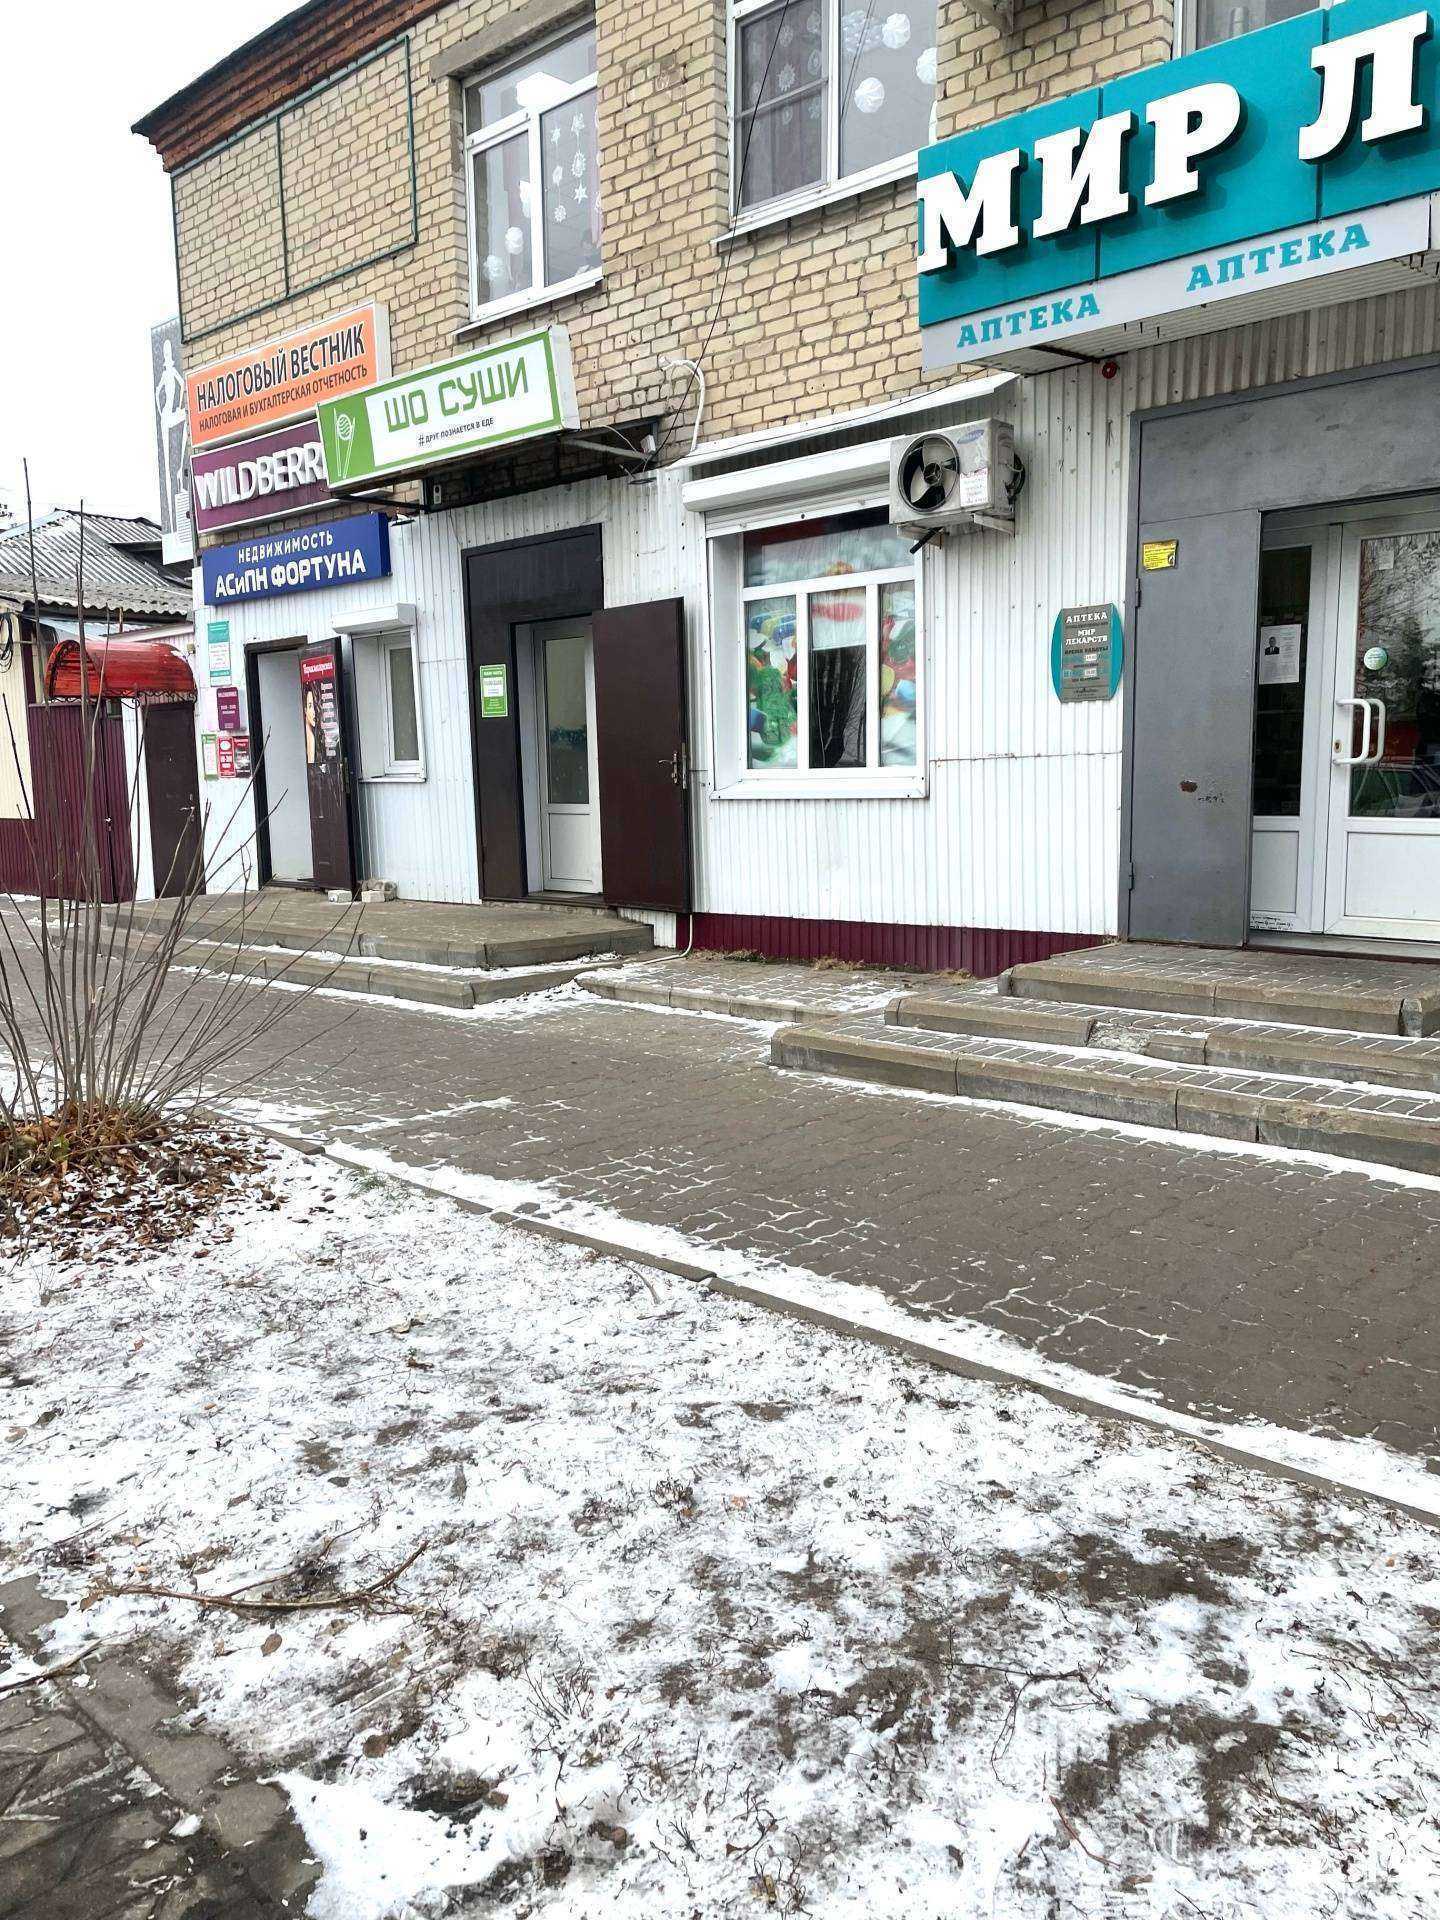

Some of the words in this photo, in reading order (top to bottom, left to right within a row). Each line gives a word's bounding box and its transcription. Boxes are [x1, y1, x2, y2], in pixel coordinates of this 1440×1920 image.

[917, 82, 1241, 274] МИР
[957, 292, 1100, 348] АПТЕКА
[1186, 223, 1370, 292] АПТЕКА
[197, 349, 287, 412] НАЛОГОВЫЙ
[291, 324, 365, 379] ВЕСТНИК
[200, 408, 242, 432] НАЛОГОВАЯ
[243, 404, 249, 417] И
[250, 382, 311, 416] БУХГАЛТЕРСКАЯ
[313, 364, 367, 393] ОТЧЕТНОСТЬ
[384, 389, 429, 432] ШО
[438, 357, 529, 416] СУШИ
[440, 422, 475, 438] ПОЗНАЕТСЯ
[476, 420, 481, 428] В
[482, 417, 494, 428] ЕДЕ
[238, 530, 333, 563] НЕДВИЖИМОСТЬ
[271, 549, 366, 588] ФОРТУНА
[1066, 611, 1108, 623] АПТЕКА
[1078, 628, 1095, 637] МИР
[1065, 635, 1108, 645] ЛЕКАРСТВ
